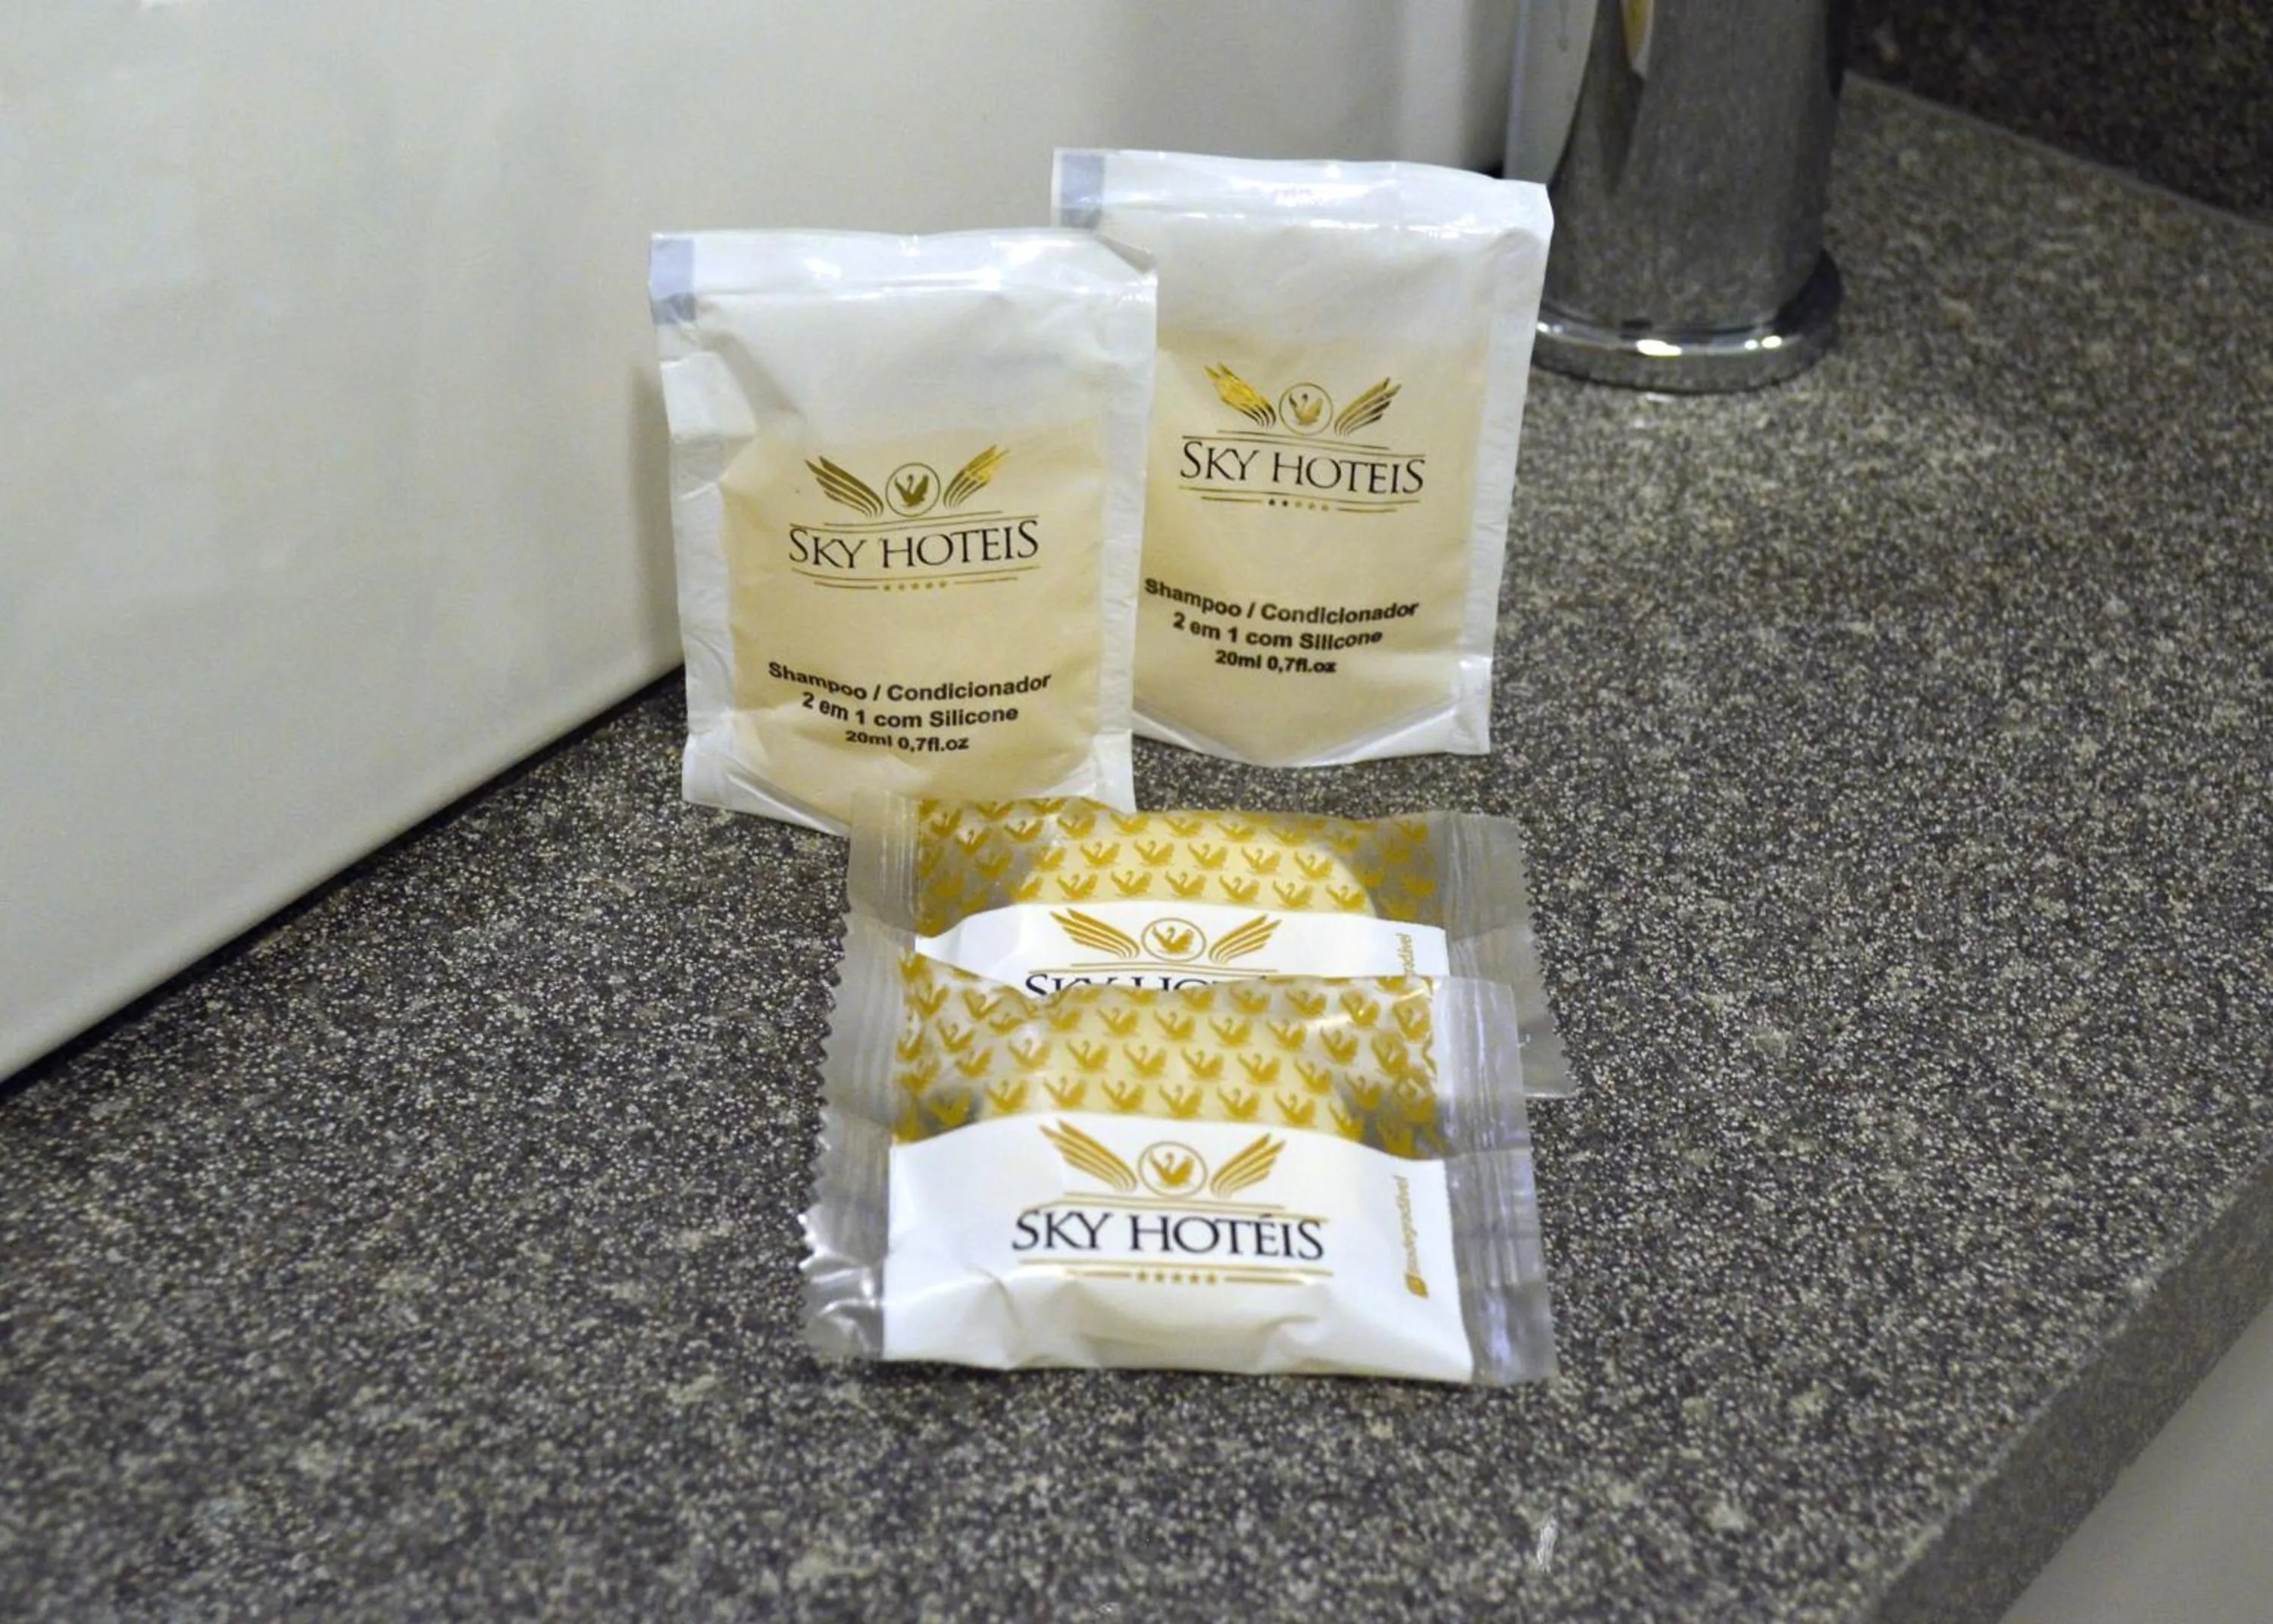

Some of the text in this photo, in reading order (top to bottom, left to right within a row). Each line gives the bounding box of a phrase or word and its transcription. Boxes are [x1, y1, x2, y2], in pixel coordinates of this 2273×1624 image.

[1180, 439, 1426, 495] SKY HOTEIS
[789, 519, 1040, 569] SKY HOTEIS
[1144, 577, 1242, 617] Shampoo
[1261, 602, 1420, 625] Condicionador
[1173, 611, 1383, 651] 2 em 1 com Silicone
[1215, 649, 1262, 670] 20ml
[768, 661, 868, 701] Shampoo
[887, 673, 1052, 702] Condicionador
[802, 691, 1019, 729] 2 em 1 com Silicone
[845, 730, 893, 748] 20ml
[1011, 1209, 1324, 1260] SKY HOTÉIS
